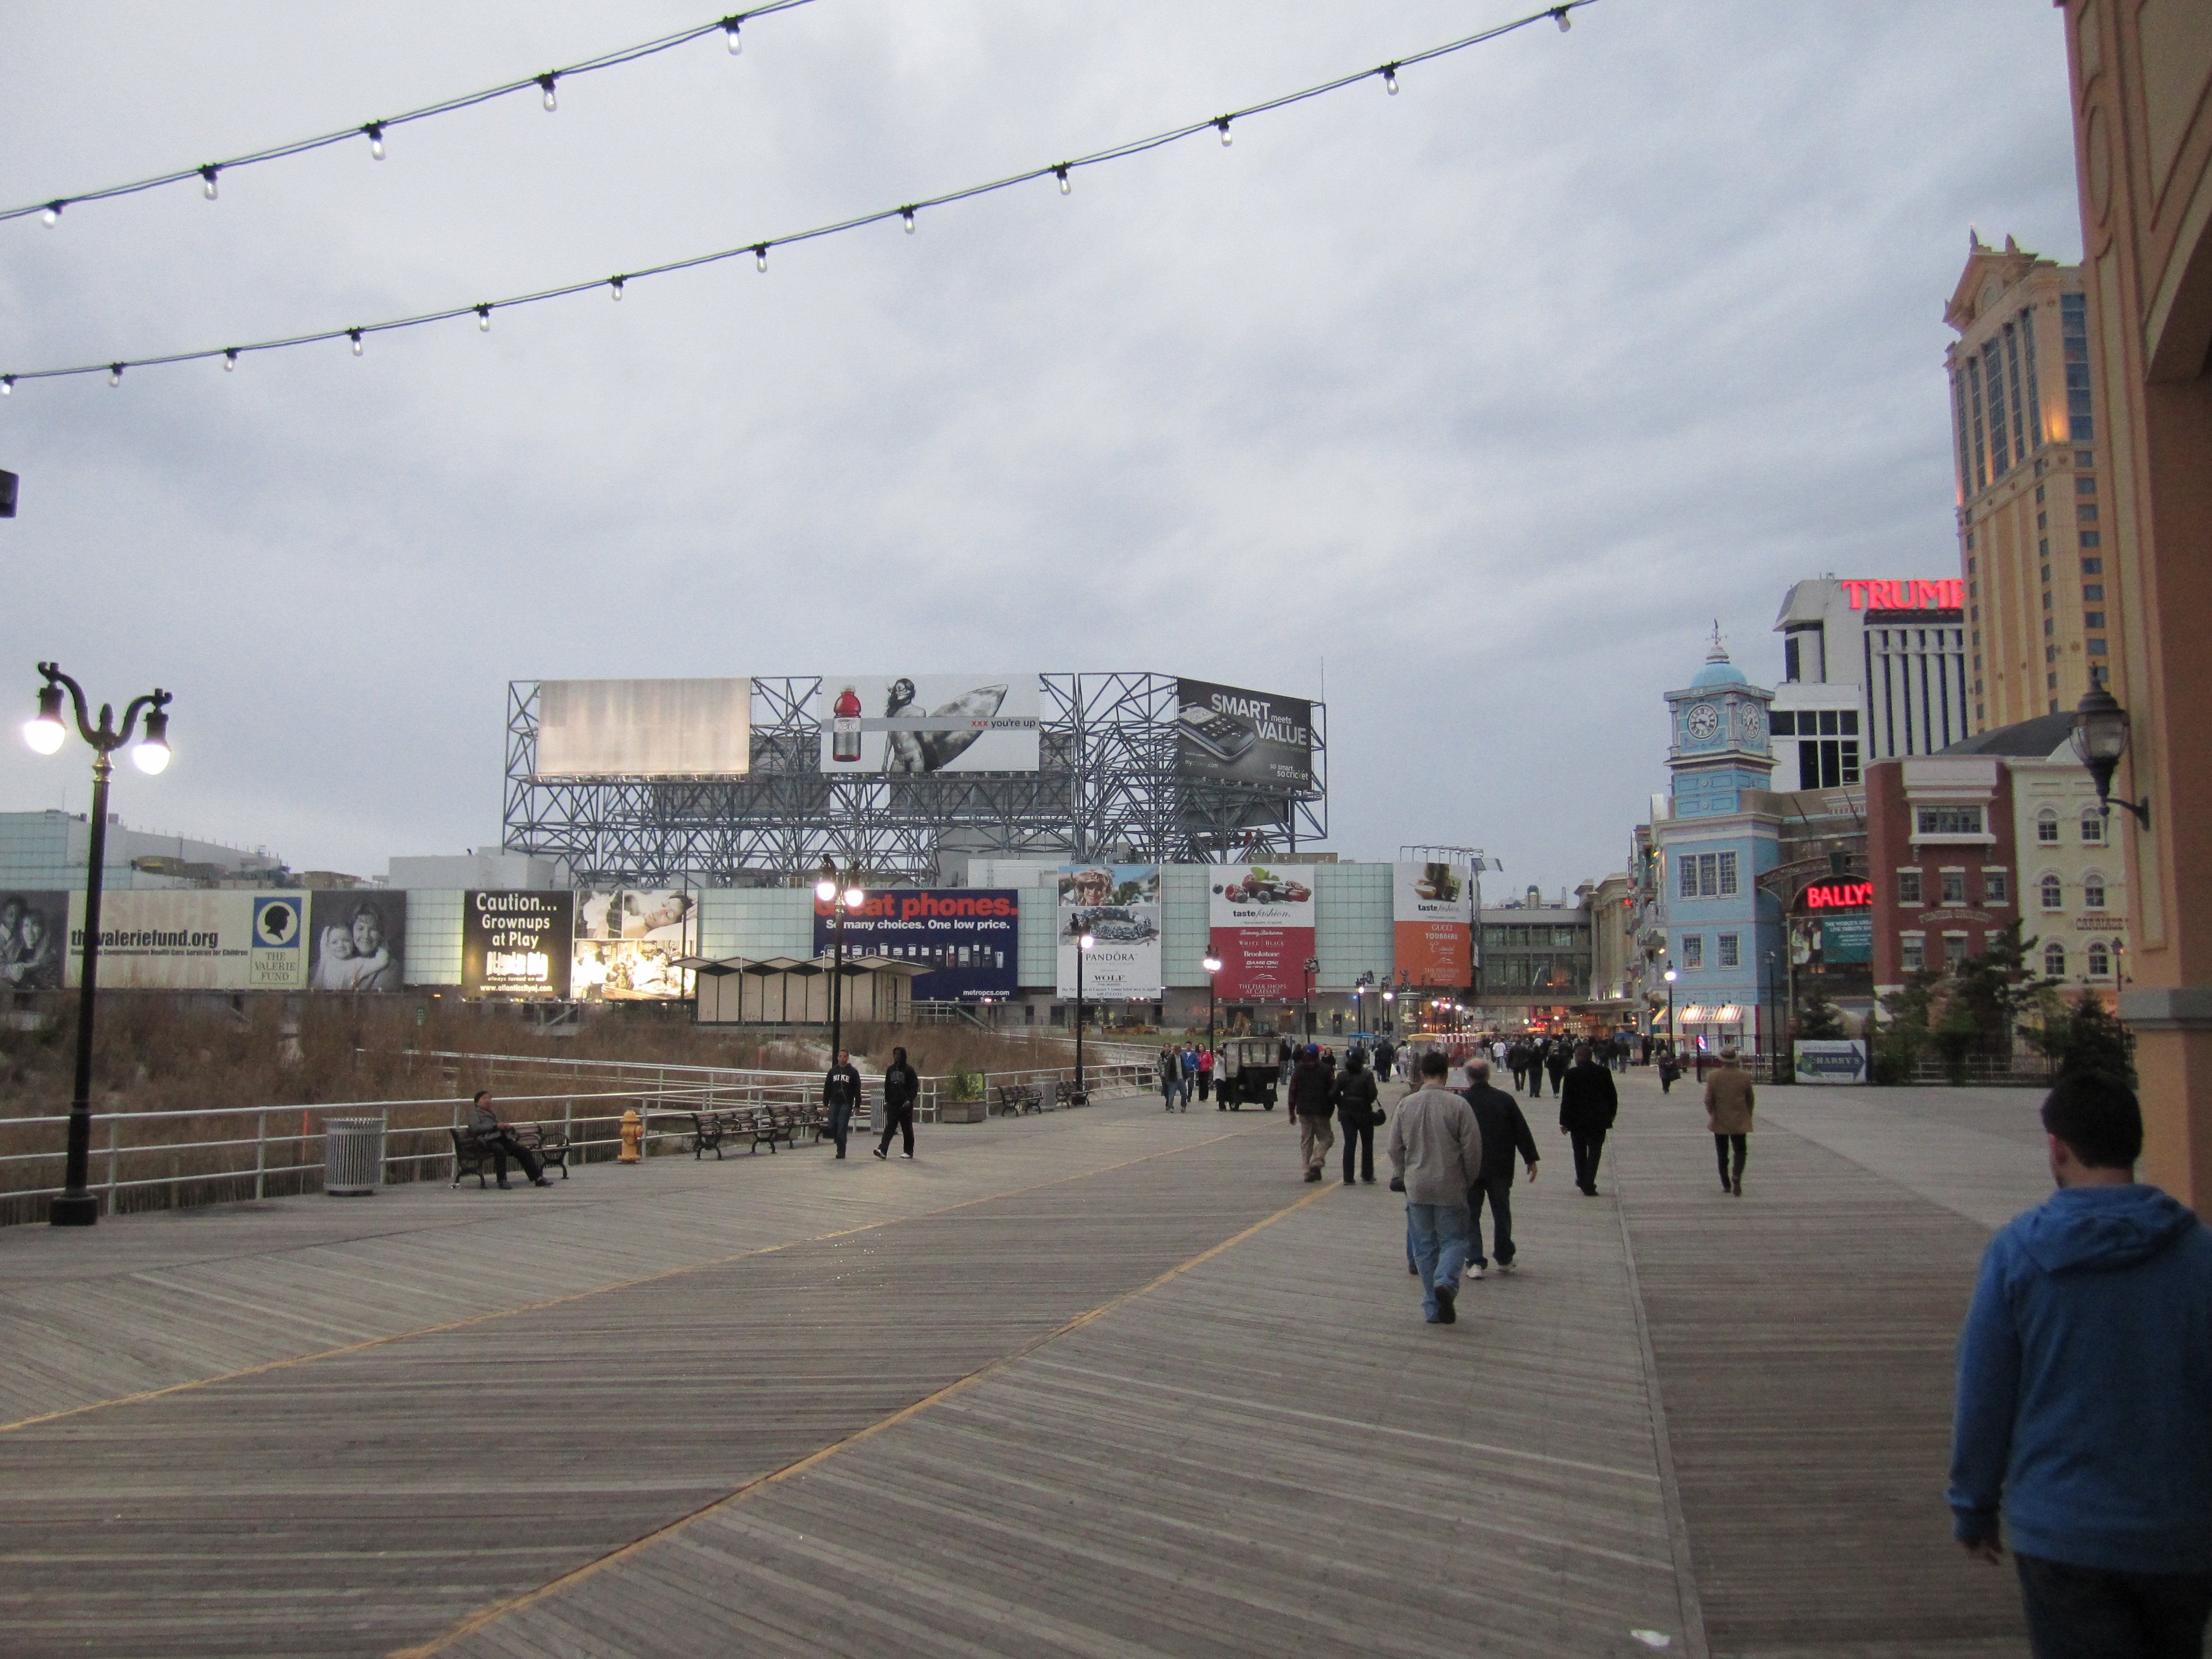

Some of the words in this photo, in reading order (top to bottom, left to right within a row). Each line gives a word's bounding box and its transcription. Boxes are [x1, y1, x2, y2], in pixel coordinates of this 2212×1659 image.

[1211, 693, 1270, 720] SMART
[991, 718, 1020, 729] you're
[1023, 719, 1036, 729] up
[1271, 714, 1292, 724] meets
[1256, 720, 1307, 746] VALUE
[1286, 769, 1308, 780] cricket
[476, 892, 557, 911] Caution...
[902, 892, 1018, 922] phones.
[1255, 907, 1291, 919] fashion.
[482, 913, 550, 931] Grownups
[843, 921, 875, 931] many
[877, 919, 924, 930] choices.
[928, 919, 951, 930] One
[953, 919, 974, 929] low
[977, 920, 1010, 931] price.
[72, 929, 219, 948] thvaleriefund.org
[492, 932, 506, 947] at
[509, 931, 539, 949] Play
[266, 952, 286, 961] THE
[255, 962, 296, 971] VALERIE
[261, 972, 289, 981] FUND
[833, 1074, 850, 1082] NIKE
